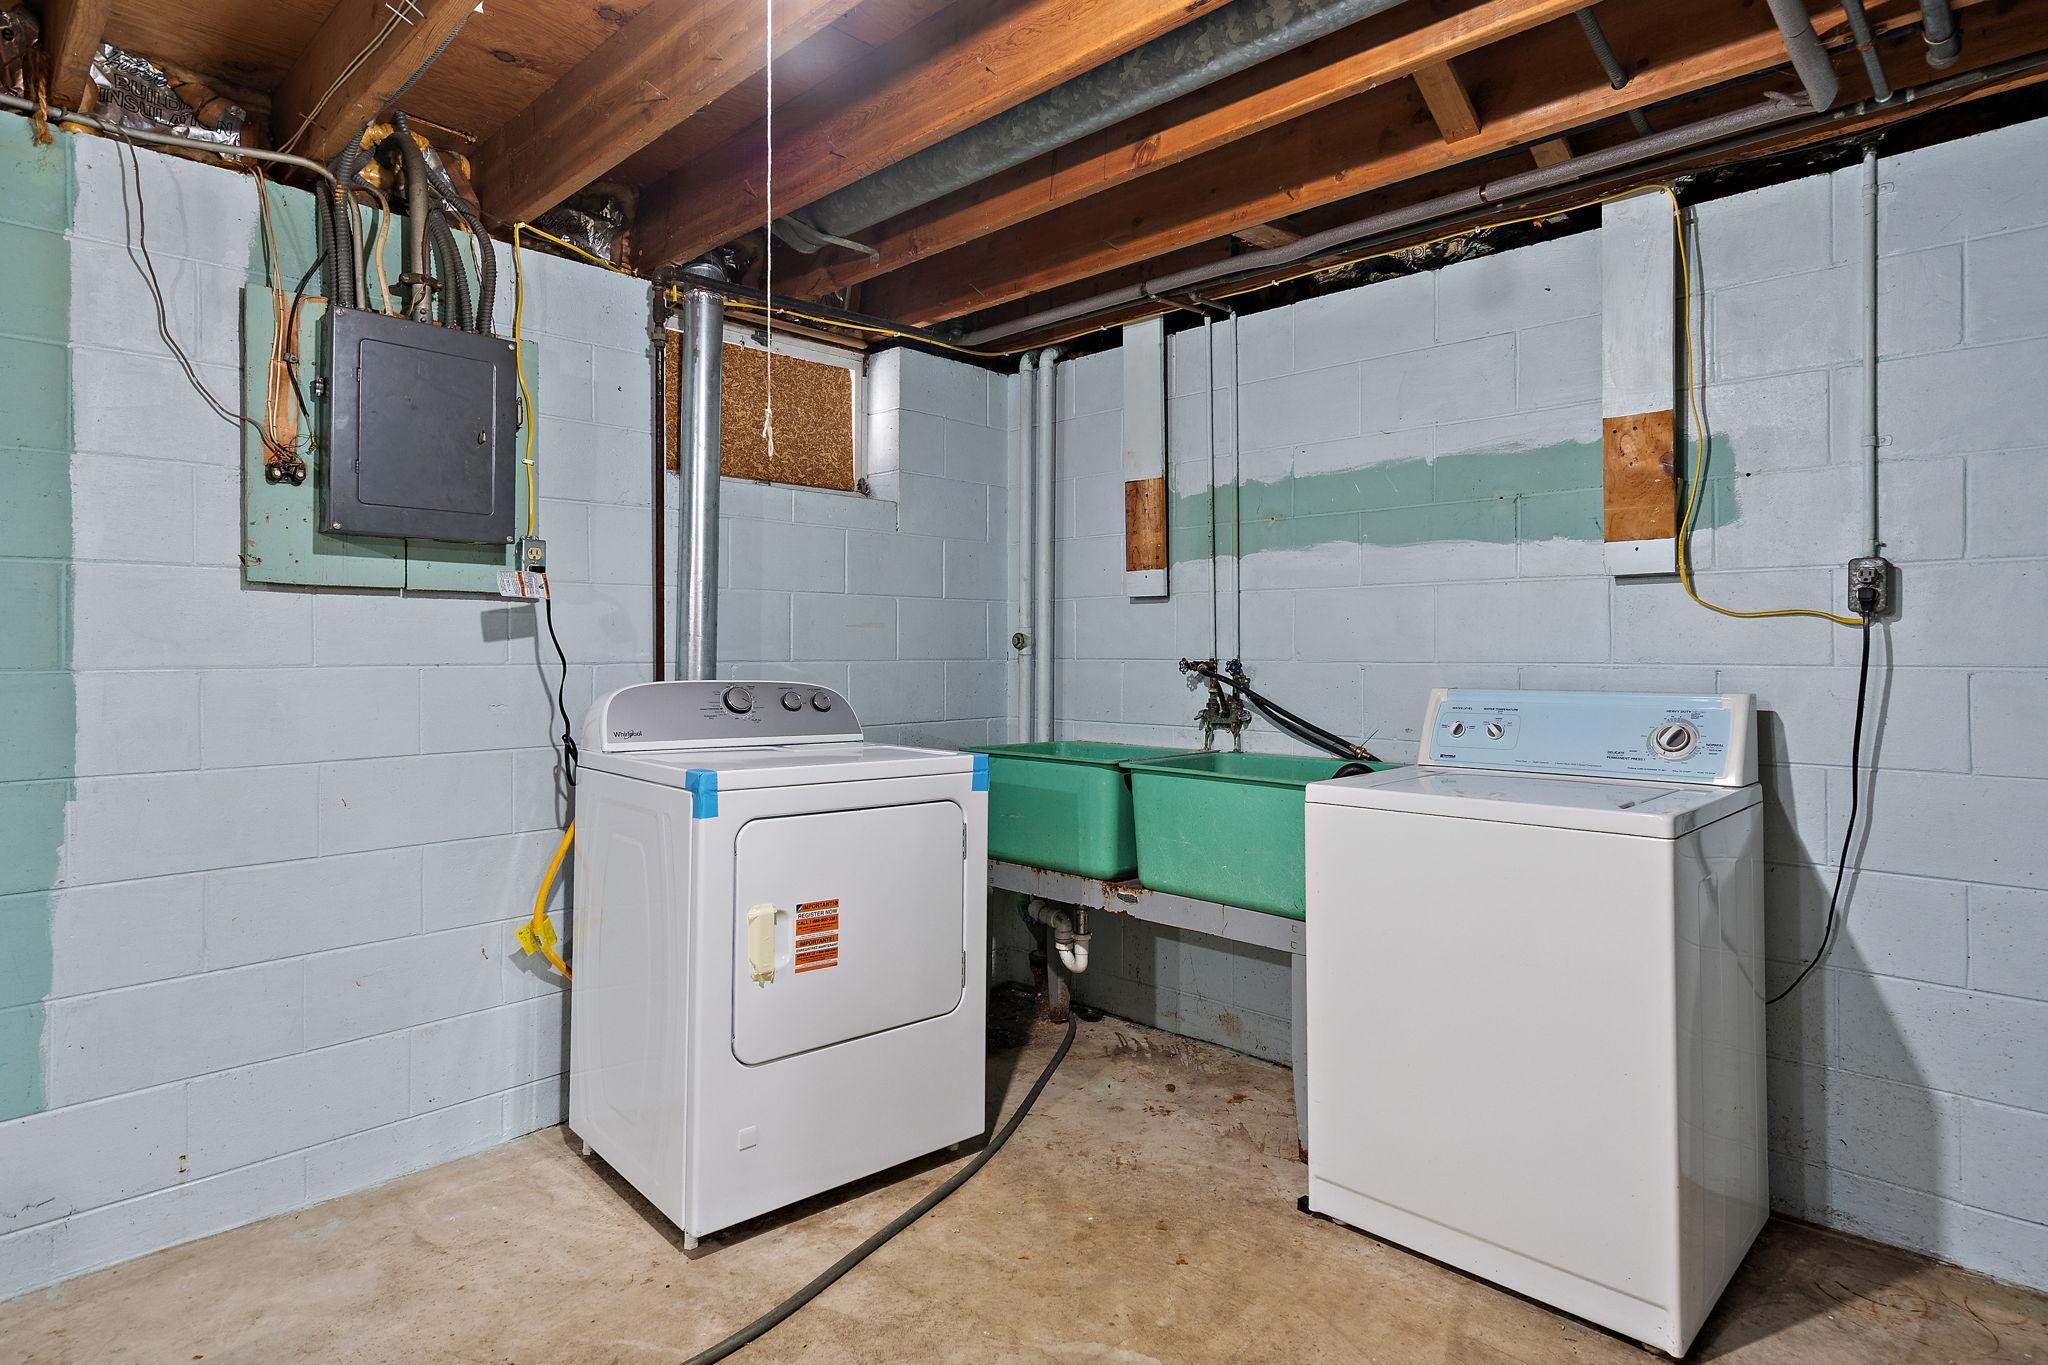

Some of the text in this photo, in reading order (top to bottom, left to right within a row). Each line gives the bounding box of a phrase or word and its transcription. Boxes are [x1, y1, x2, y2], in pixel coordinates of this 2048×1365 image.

[98, 87, 232, 136] INSULATIN
[613, 730, 643, 740] Whirlpool
[797, 911, 825, 919] REGISTER
